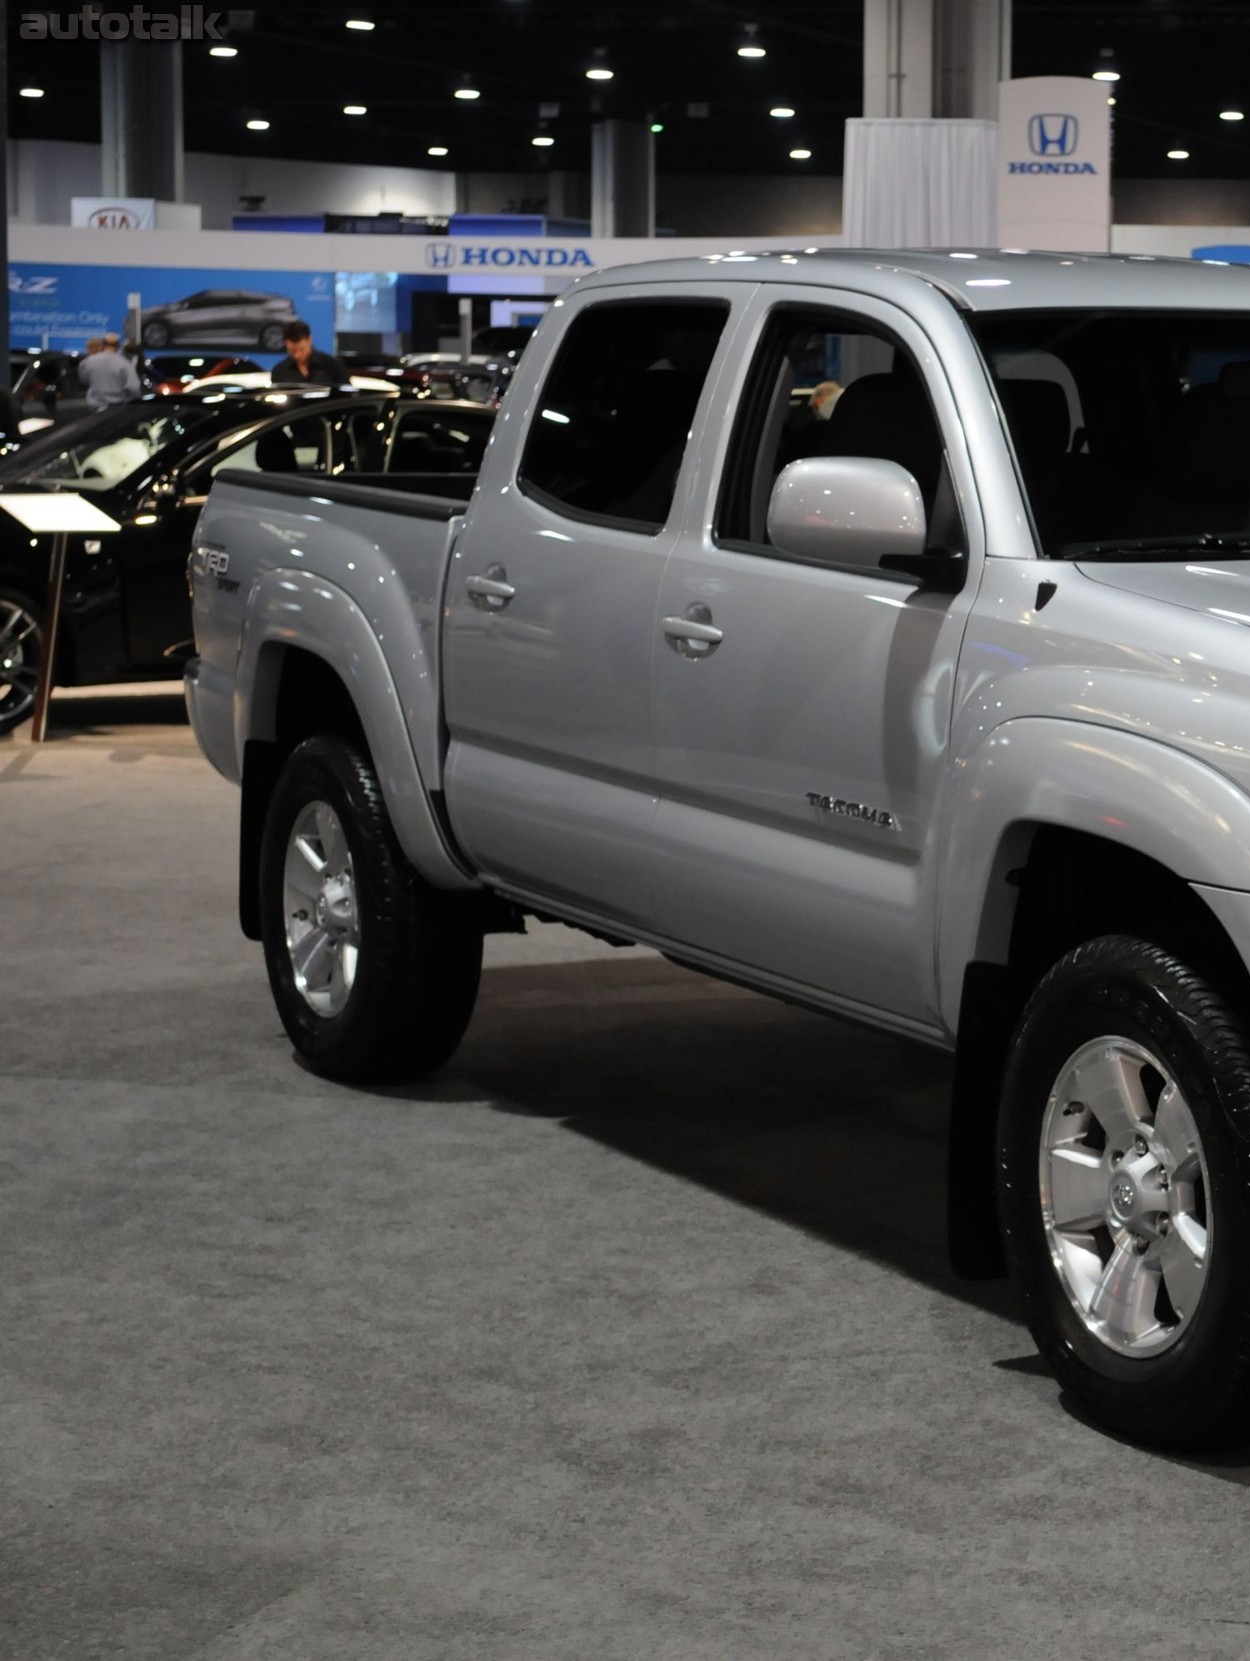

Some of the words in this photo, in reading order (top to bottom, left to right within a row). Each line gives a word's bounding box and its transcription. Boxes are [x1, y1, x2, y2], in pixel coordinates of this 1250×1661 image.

[1008, 161, 1097, 175] HONDA
[96, 214, 131, 230] KIA
[462, 247, 594, 267] HONDA
[8, 276, 59, 294] R-Z
[806, 792, 901, 831] TACOMA
